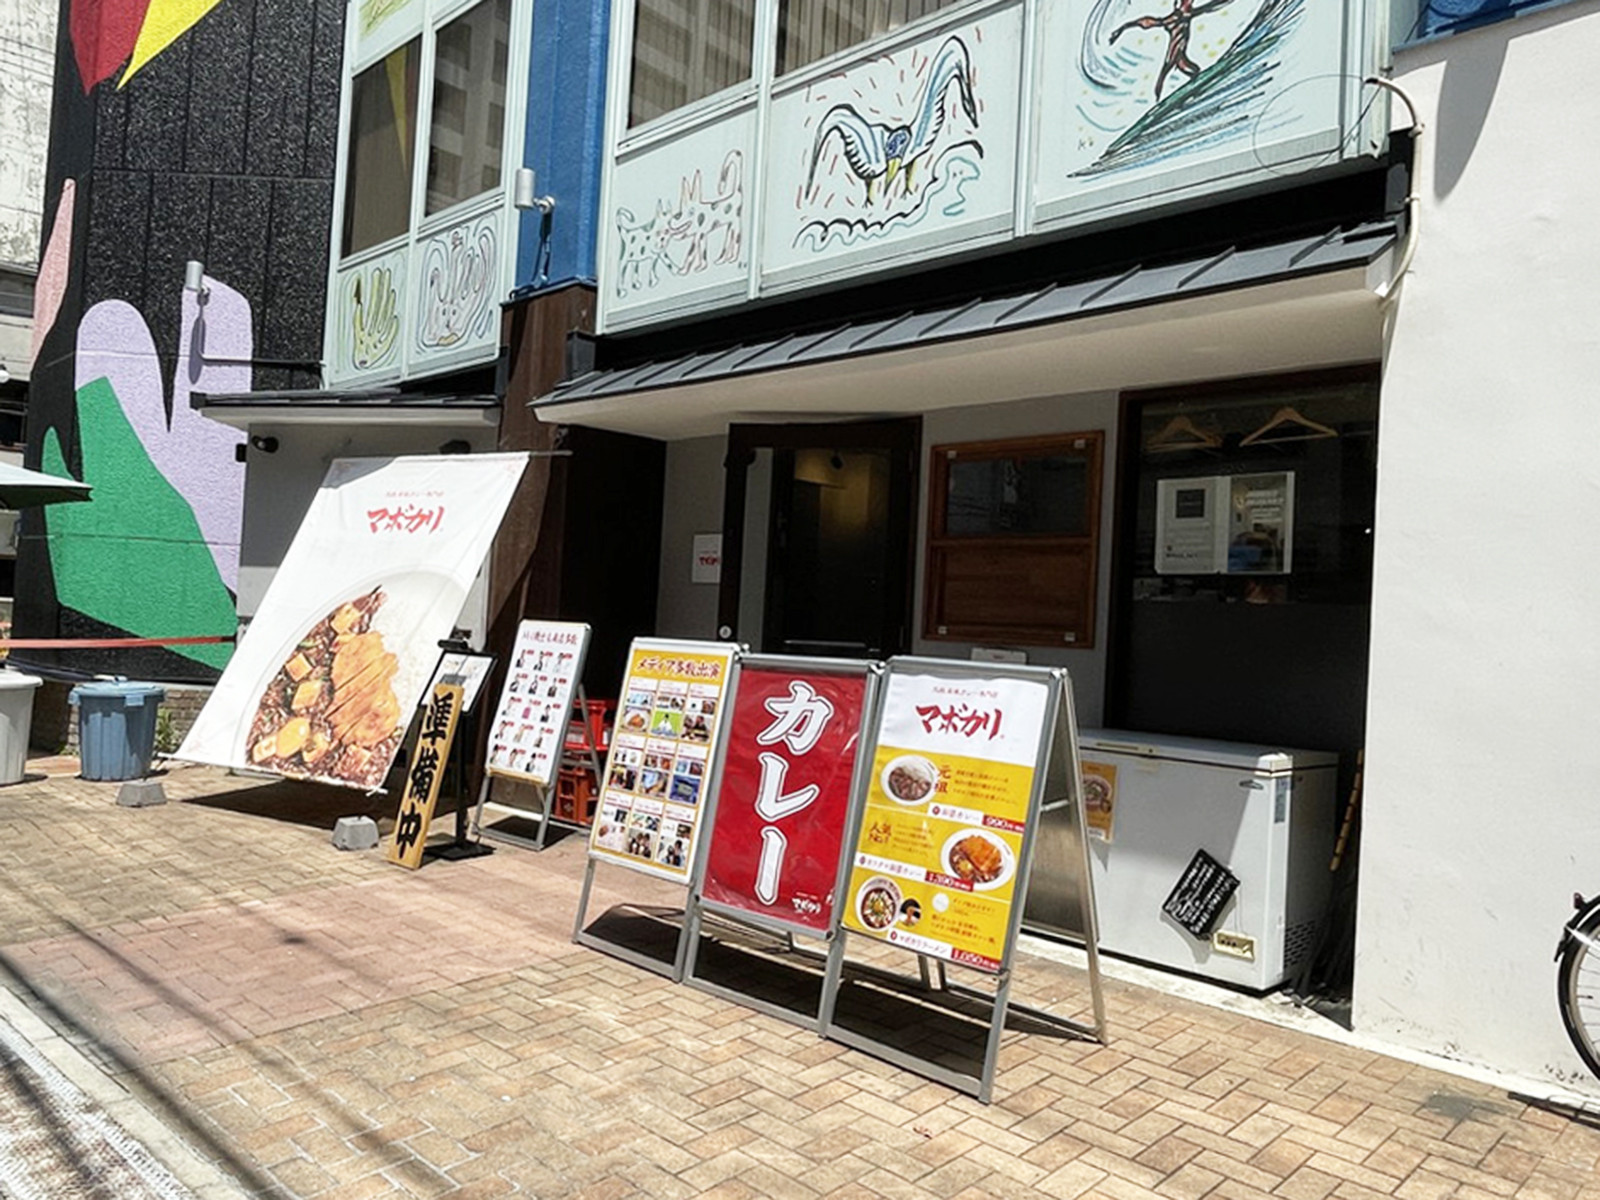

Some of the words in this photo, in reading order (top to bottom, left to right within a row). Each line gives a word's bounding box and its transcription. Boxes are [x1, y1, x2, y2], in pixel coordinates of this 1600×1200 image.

[367, 504, 445, 534] マボカリ
[637, 657, 721, 678] メディア多数出演
[915, 703, 1003, 740] マボカリ
[396, 692, 453, 859] 準備中
[755, 680, 835, 908] カレー
